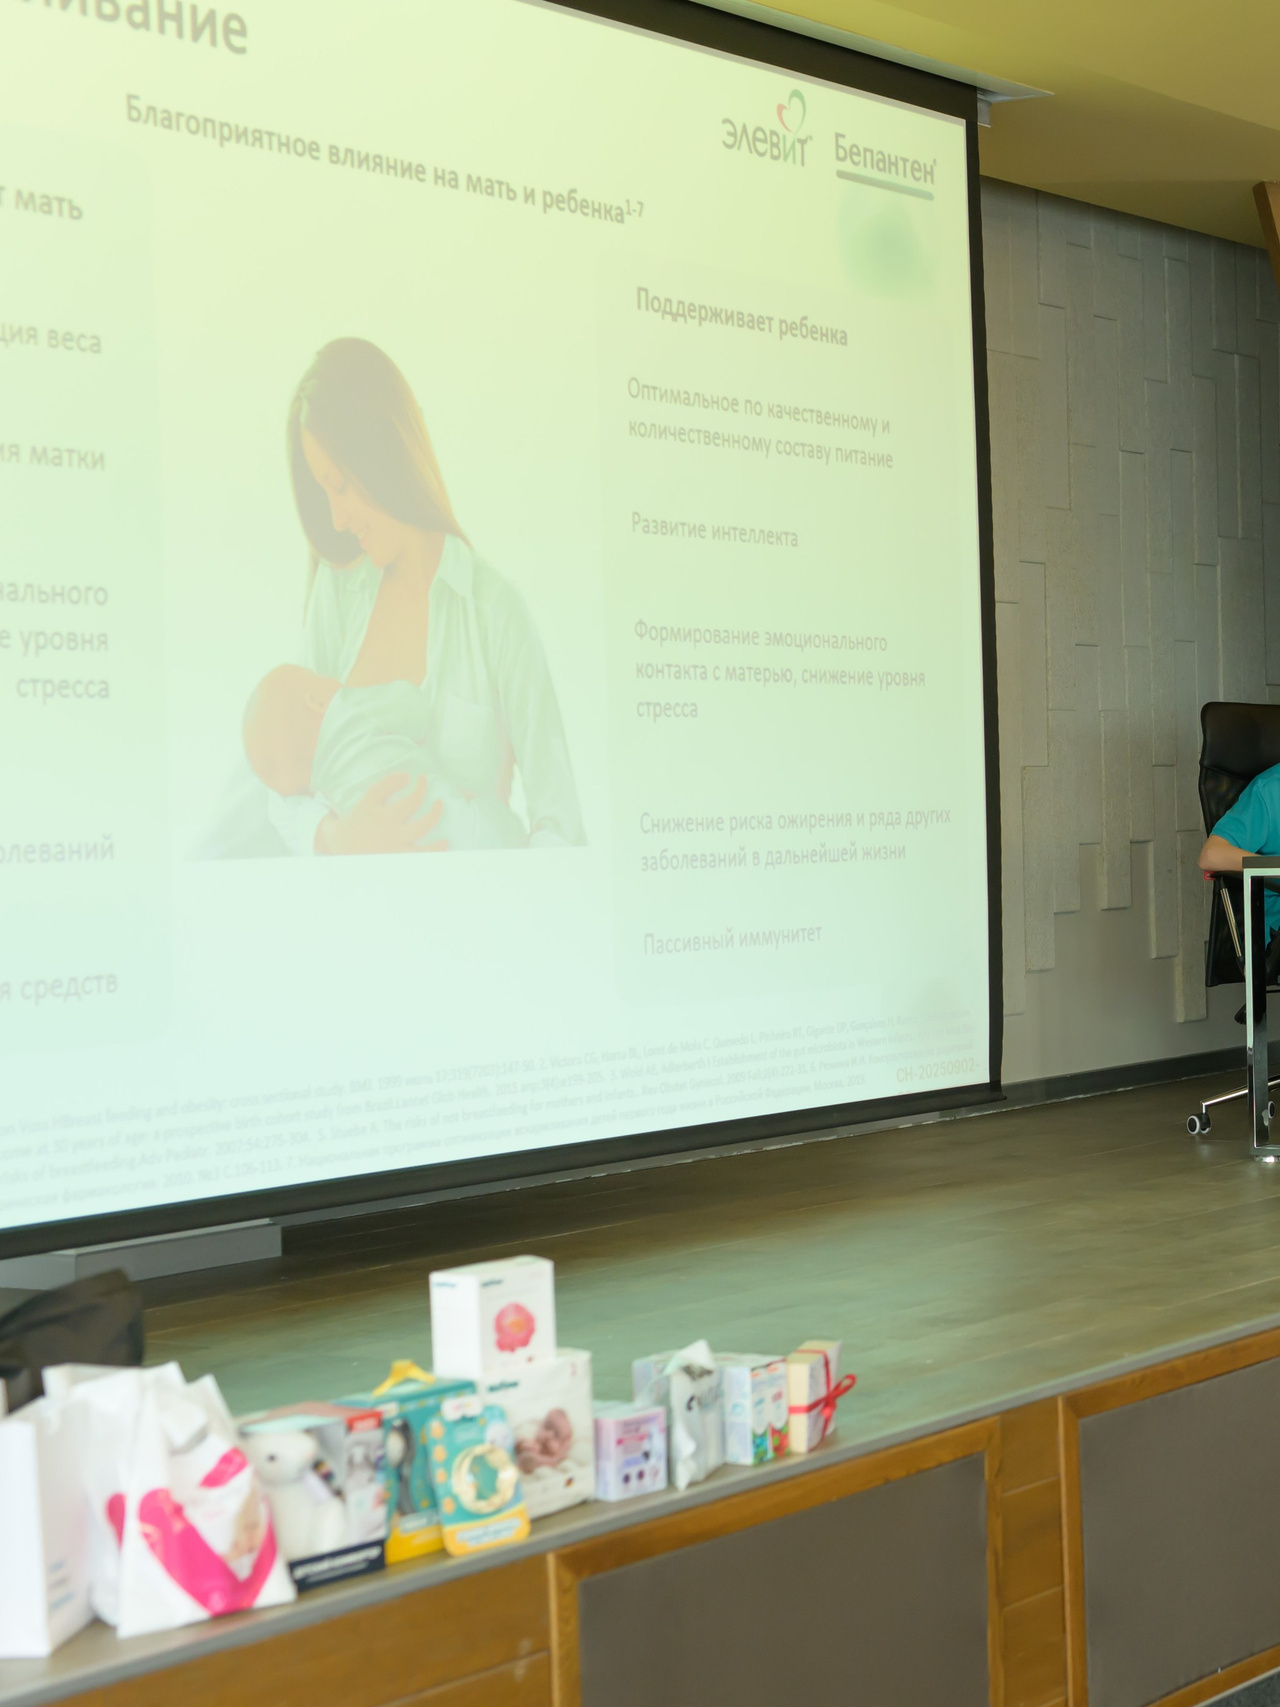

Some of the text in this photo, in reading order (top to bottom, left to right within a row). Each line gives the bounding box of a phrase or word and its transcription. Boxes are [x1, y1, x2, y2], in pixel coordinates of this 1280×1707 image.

[22, 0, 248, 55] вание
[126, 93, 321, 161] Благоприятное
[328, 144, 427, 182] влияние
[433, 166, 459, 189] на
[466, 173, 517, 202] мать
[523, 186, 535, 206] и
[15, 189, 83, 220] мать
[637, 286, 848, 346] Поддерживает ребенка
[48, 328, 102, 354] веса
[627, 377, 890, 437] Оптимальное по качественному и
[30, 445, 105, 471] матки
[629, 420, 893, 469] количественному составу питание
[631, 511, 799, 548] Развитие интеллекта
[19, 630, 109, 657] уровня
[634, 618, 888, 653] Формирование эмоционального
[16, 678, 110, 705] стресса
[635, 660, 926, 691] контакта с матерью, снижение уровня
[636, 700, 698, 724] стресса
[639, 808, 951, 837] Снижение риска ожирения и ряда других
[641, 840, 906, 872] заболеваний в дальнейшей жизни
[644, 924, 823, 956] Пассивный иммунитет
[20, 973, 118, 1006] средств
